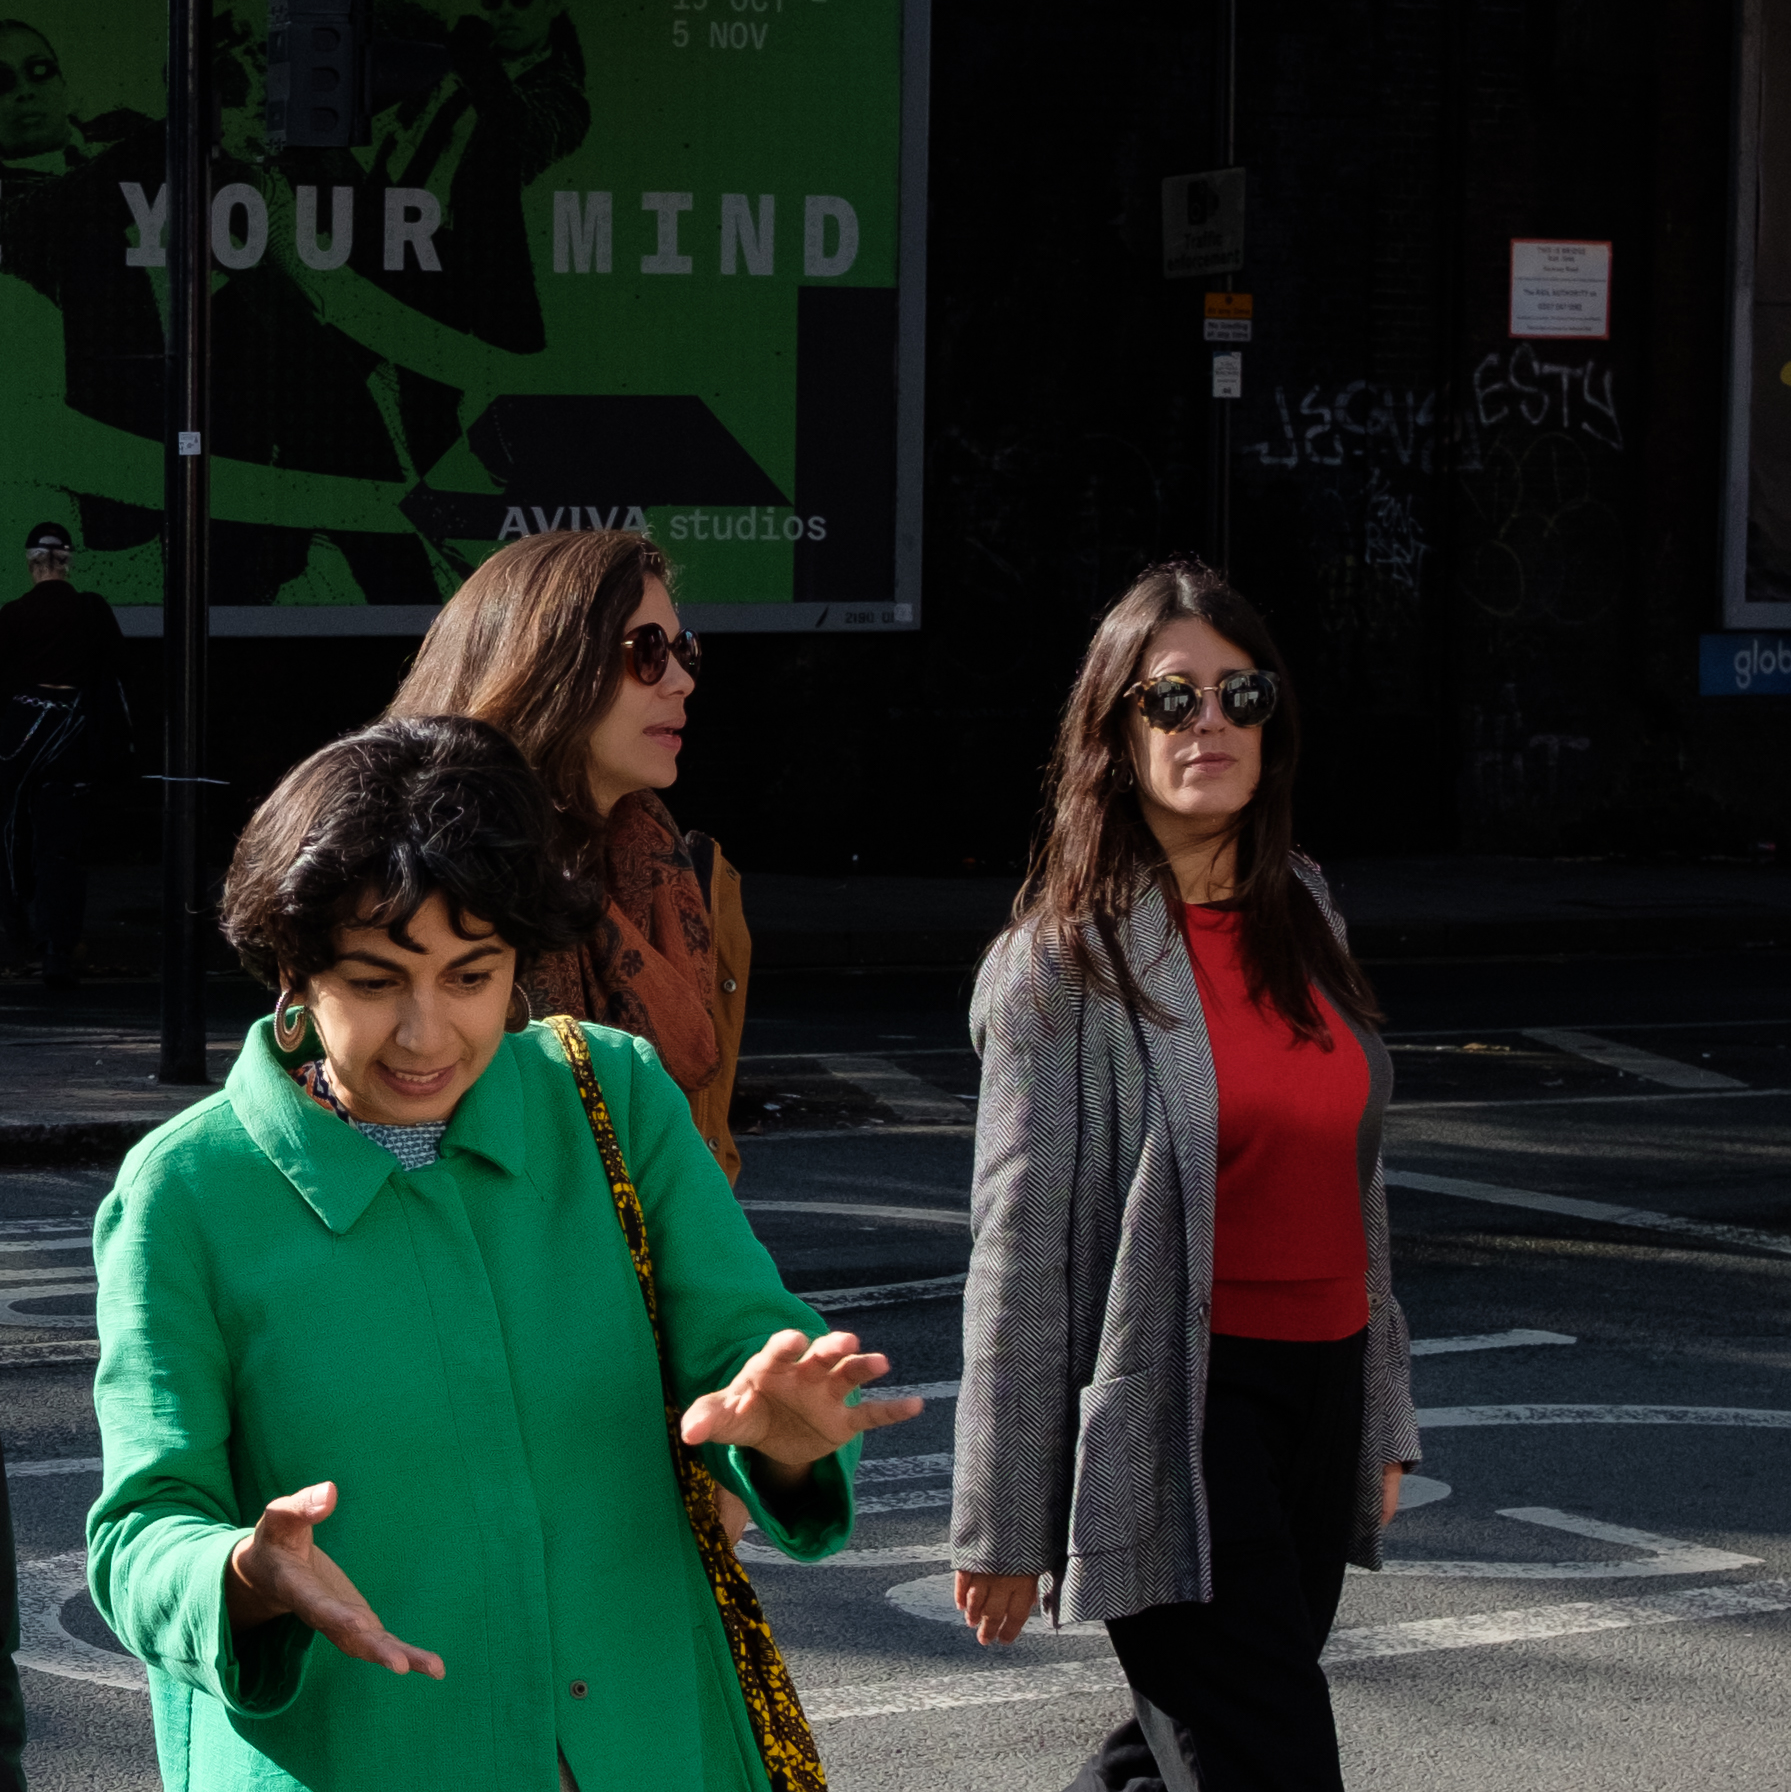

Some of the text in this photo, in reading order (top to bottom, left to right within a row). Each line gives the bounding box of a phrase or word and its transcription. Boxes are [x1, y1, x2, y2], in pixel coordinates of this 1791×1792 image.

[671, 20, 770, 51] 5 NOV
[119, 180, 443, 272] YOUR
[552, 190, 861, 278] MIND
[1184, 230, 1223, 250] Traffic
[1167, 248, 1241, 272] enforcement
[497, 505, 828, 542] AVIVA studios
[1733, 637, 1791, 691] glob
